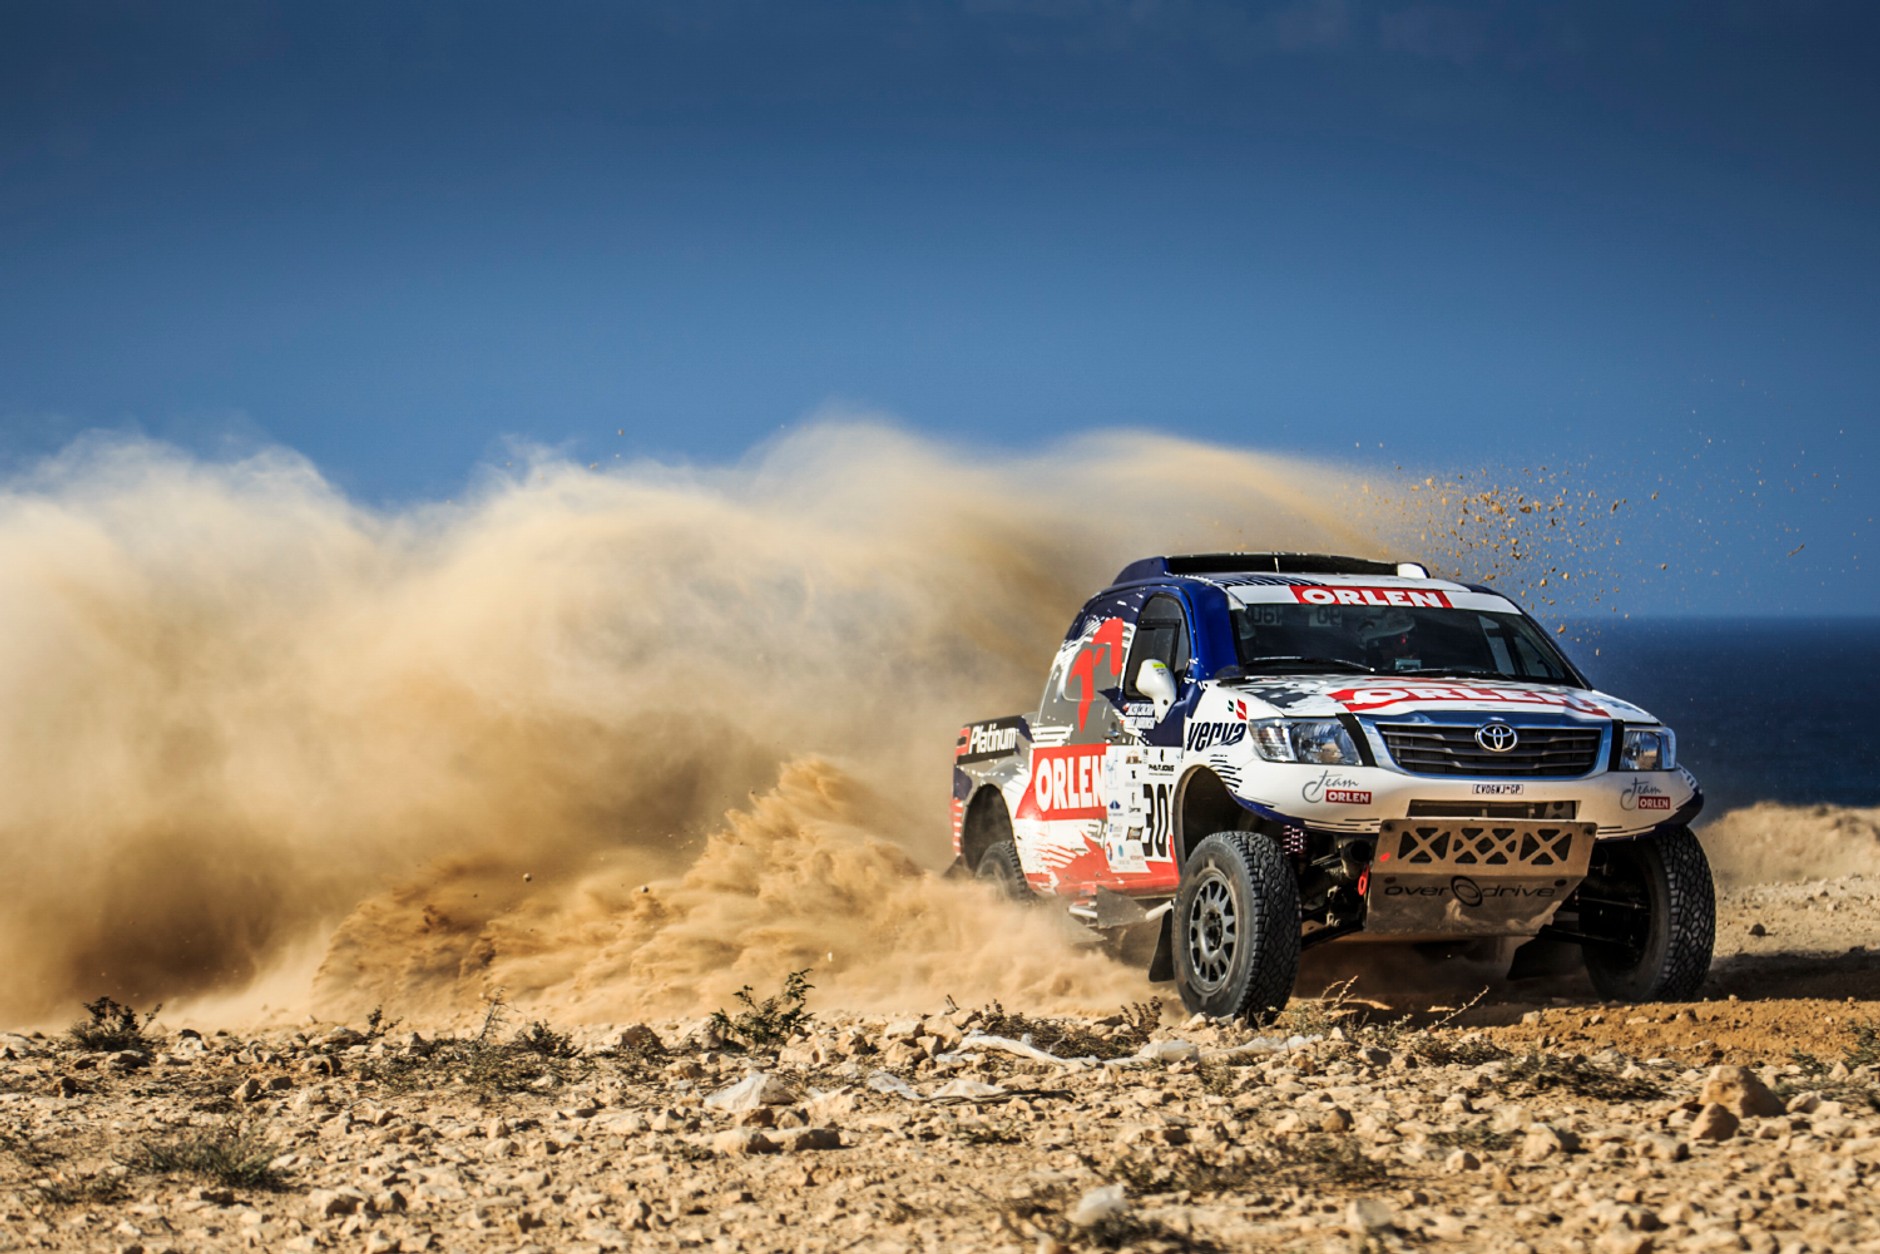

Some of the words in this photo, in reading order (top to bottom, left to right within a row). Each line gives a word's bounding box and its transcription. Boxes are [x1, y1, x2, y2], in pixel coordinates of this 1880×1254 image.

[1301, 588, 1443, 608] ORLEN
[1353, 688, 1599, 713] ORLEN
[968, 723, 1017, 754] Platinum
[1186, 721, 1247, 752] verva
[1035, 754, 1107, 812] ORLEN
[1327, 791, 1370, 802] ORLEN
[1640, 798, 1668, 808] ORLEN
